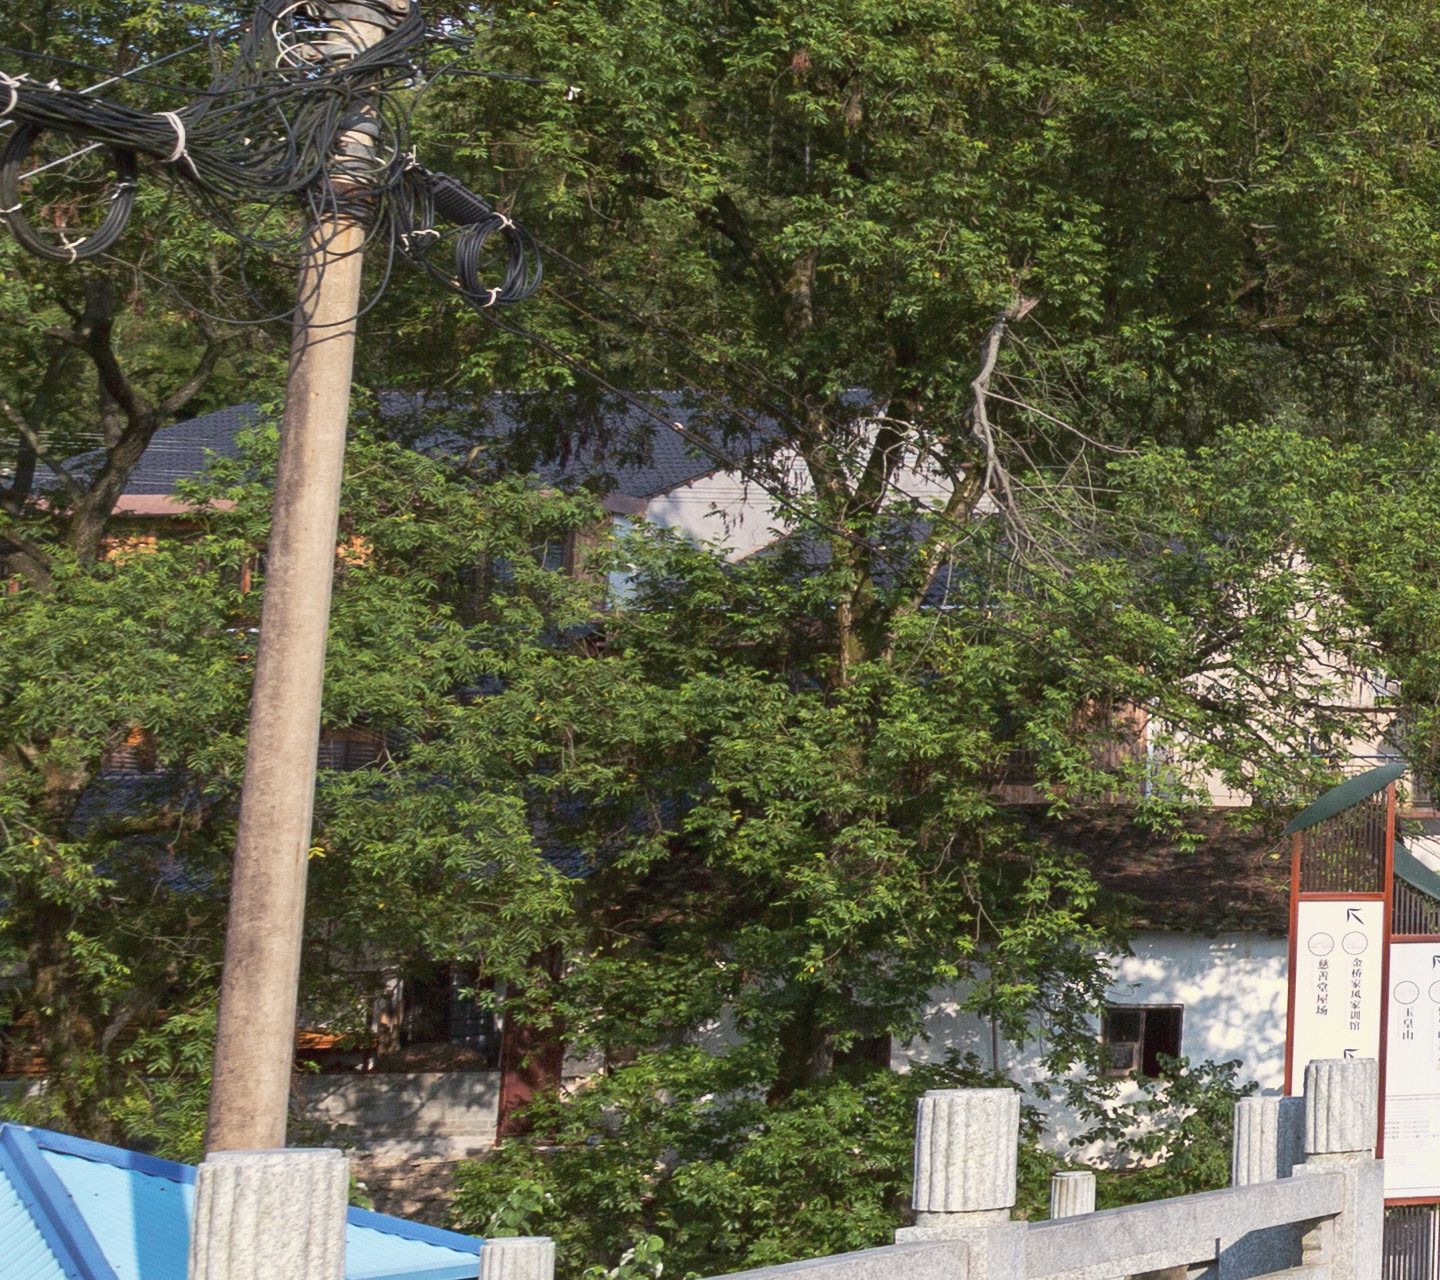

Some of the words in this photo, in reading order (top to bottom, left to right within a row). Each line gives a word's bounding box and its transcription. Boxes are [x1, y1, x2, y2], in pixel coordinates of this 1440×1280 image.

[1350, 957, 1362, 1031] 金桥家风家训馆
[1402, 1007, 1414, 1040] 玉皇山
